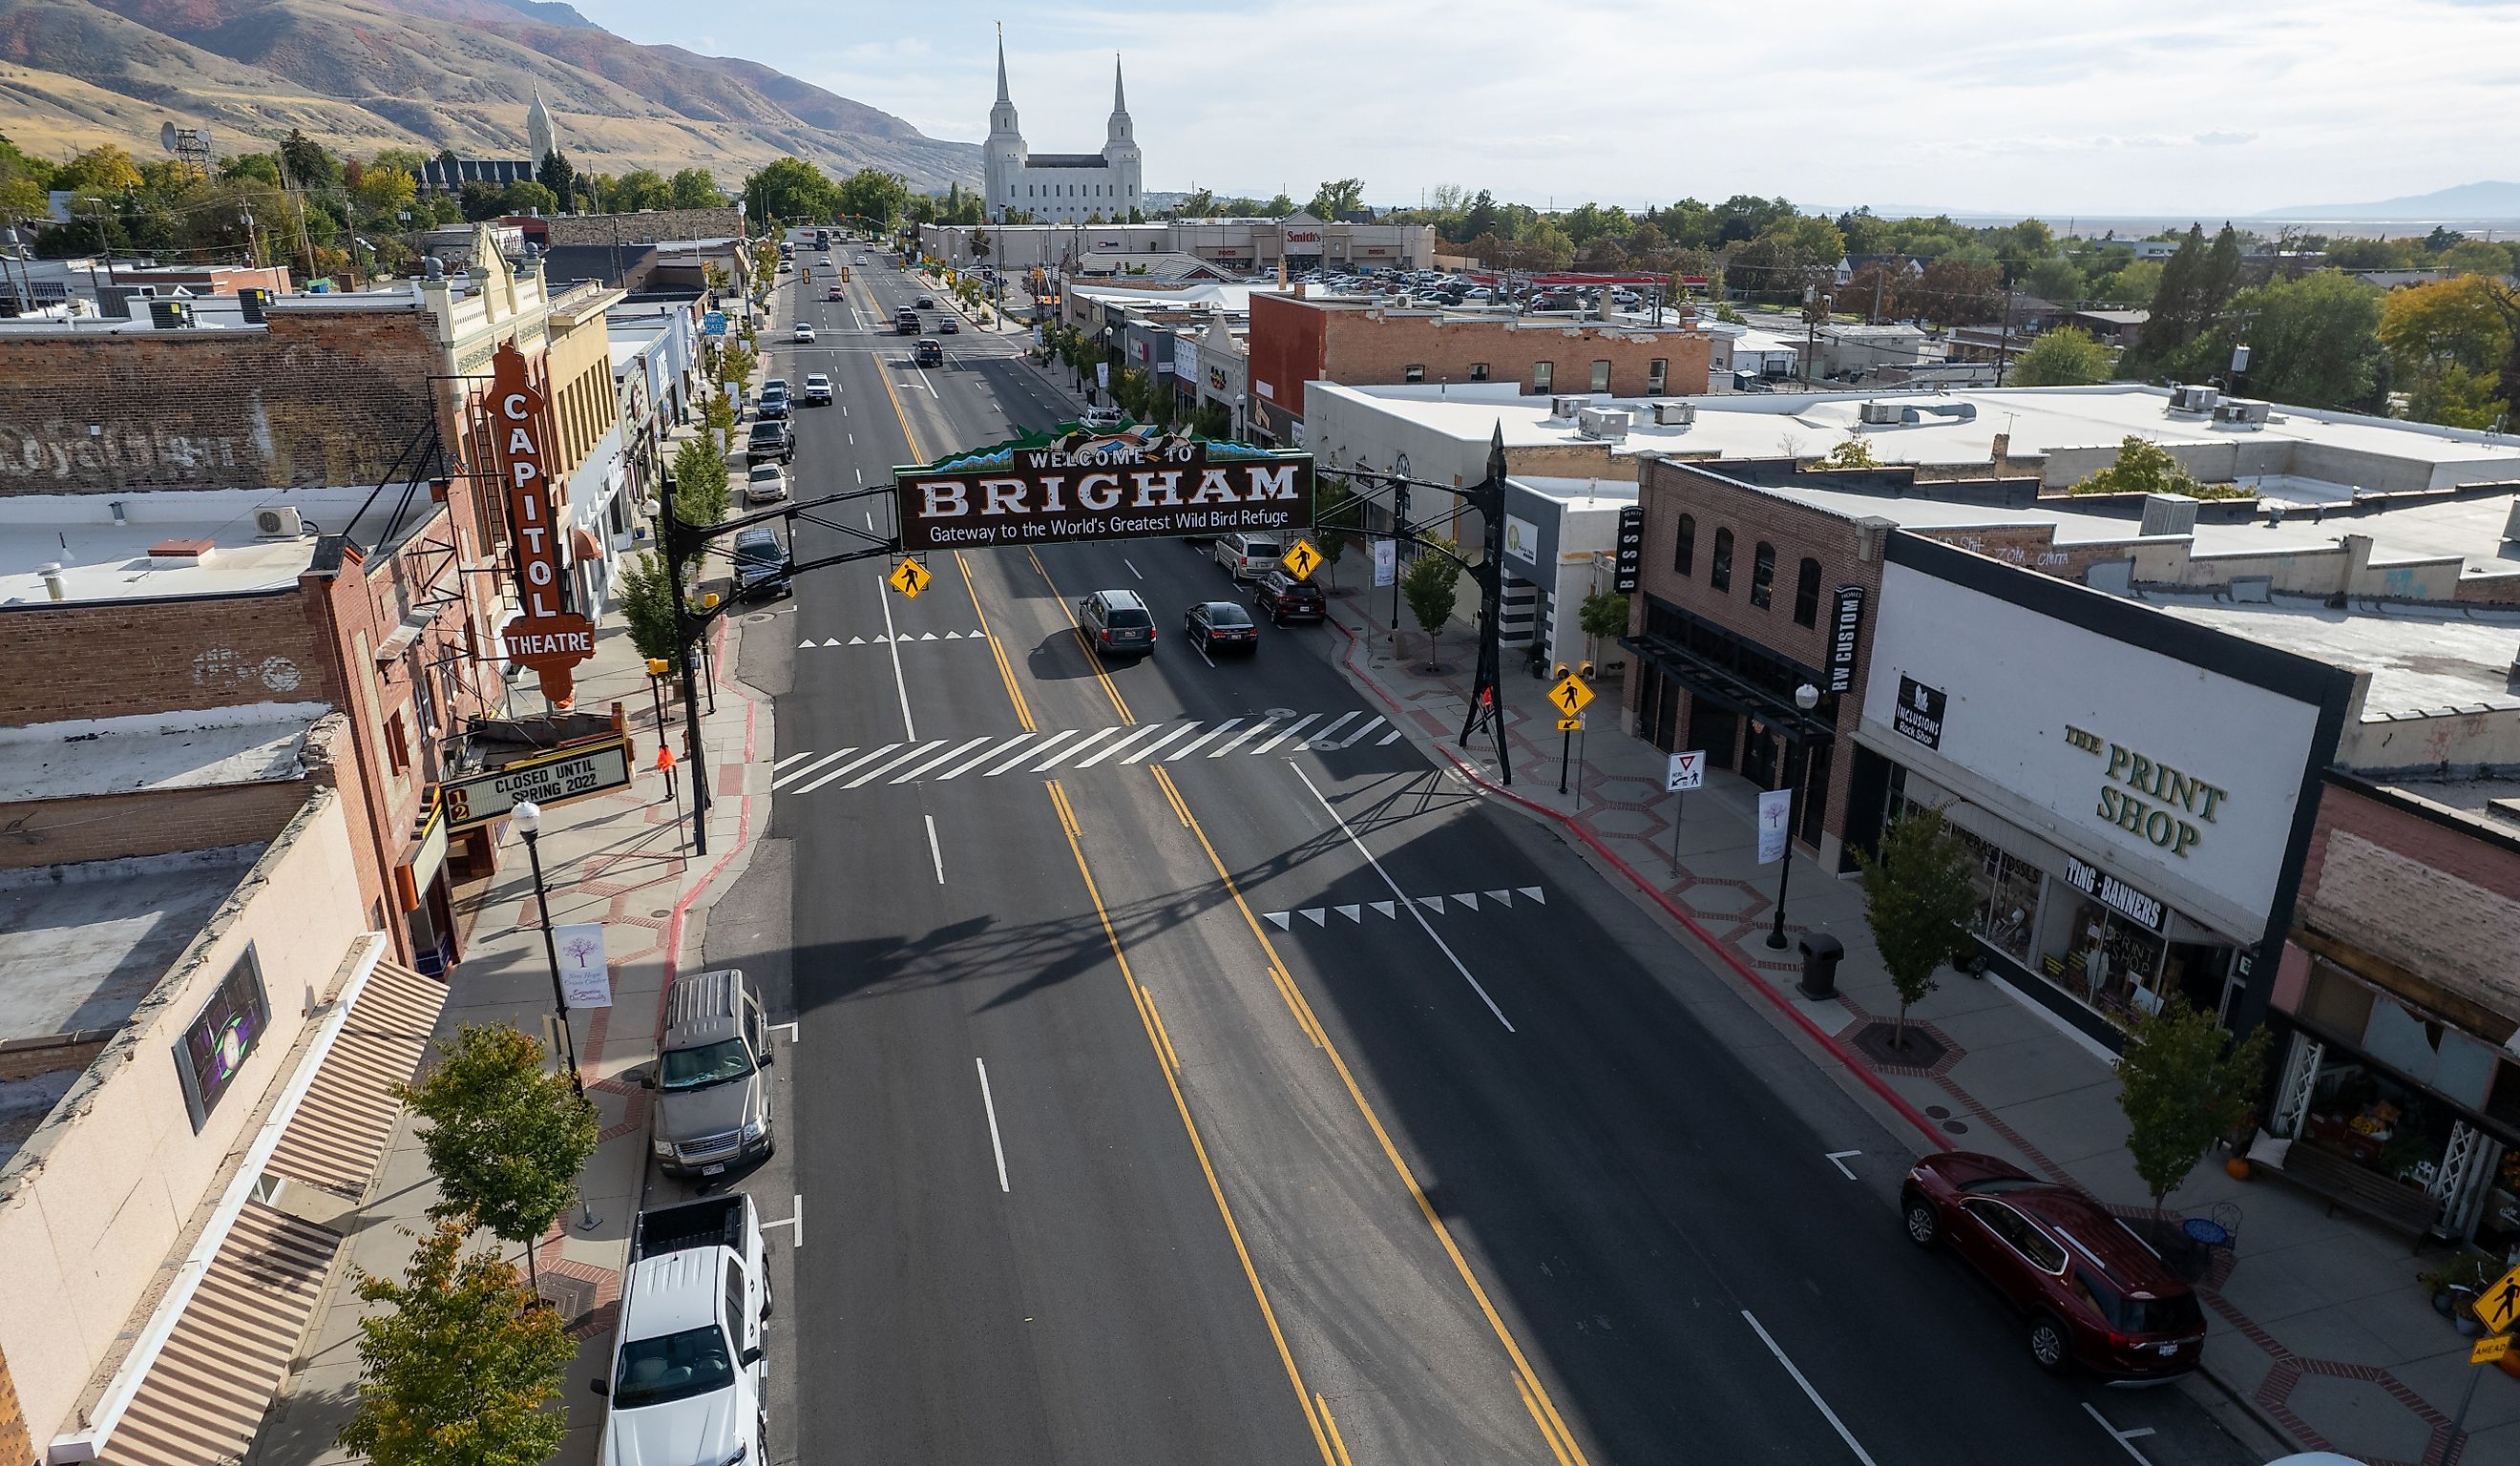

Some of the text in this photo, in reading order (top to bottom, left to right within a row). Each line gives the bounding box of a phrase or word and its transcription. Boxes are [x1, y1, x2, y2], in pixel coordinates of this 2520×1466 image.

[1287, 231, 1321, 242] Smith's
[1029, 445, 1192, 469] WELCOME TO
[504, 393, 556, 618] CAPITOL
[916, 465, 1299, 518] BRIGHAM
[931, 508, 1289, 542] Gateway to the World's Greatest Wild Bird Refuge
[1620, 520, 1640, 589] BESST
[507, 632, 592, 655] THEATRE
[1832, 599, 1858, 691] RW CUSTOM
[1897, 703, 1939, 736] INCLUSIONS
[1900, 721, 1933, 744] Rock Shop
[494, 759, 596, 793] CLOSED UNTIL
[512, 773, 597, 805] SPRING 2022
[2065, 724, 2229, 824] THE PRINT
[454, 791, 462, 803] 1
[454, 806, 468, 820] 2
[2096, 785, 2201, 859] SHOP
[2068, 858, 2161, 929] TING BANNERS
[2111, 945, 2151, 974] SHOP
[2113, 929, 2153, 961] PRINT
[2476, 1343, 2507, 1355] AHEAD
